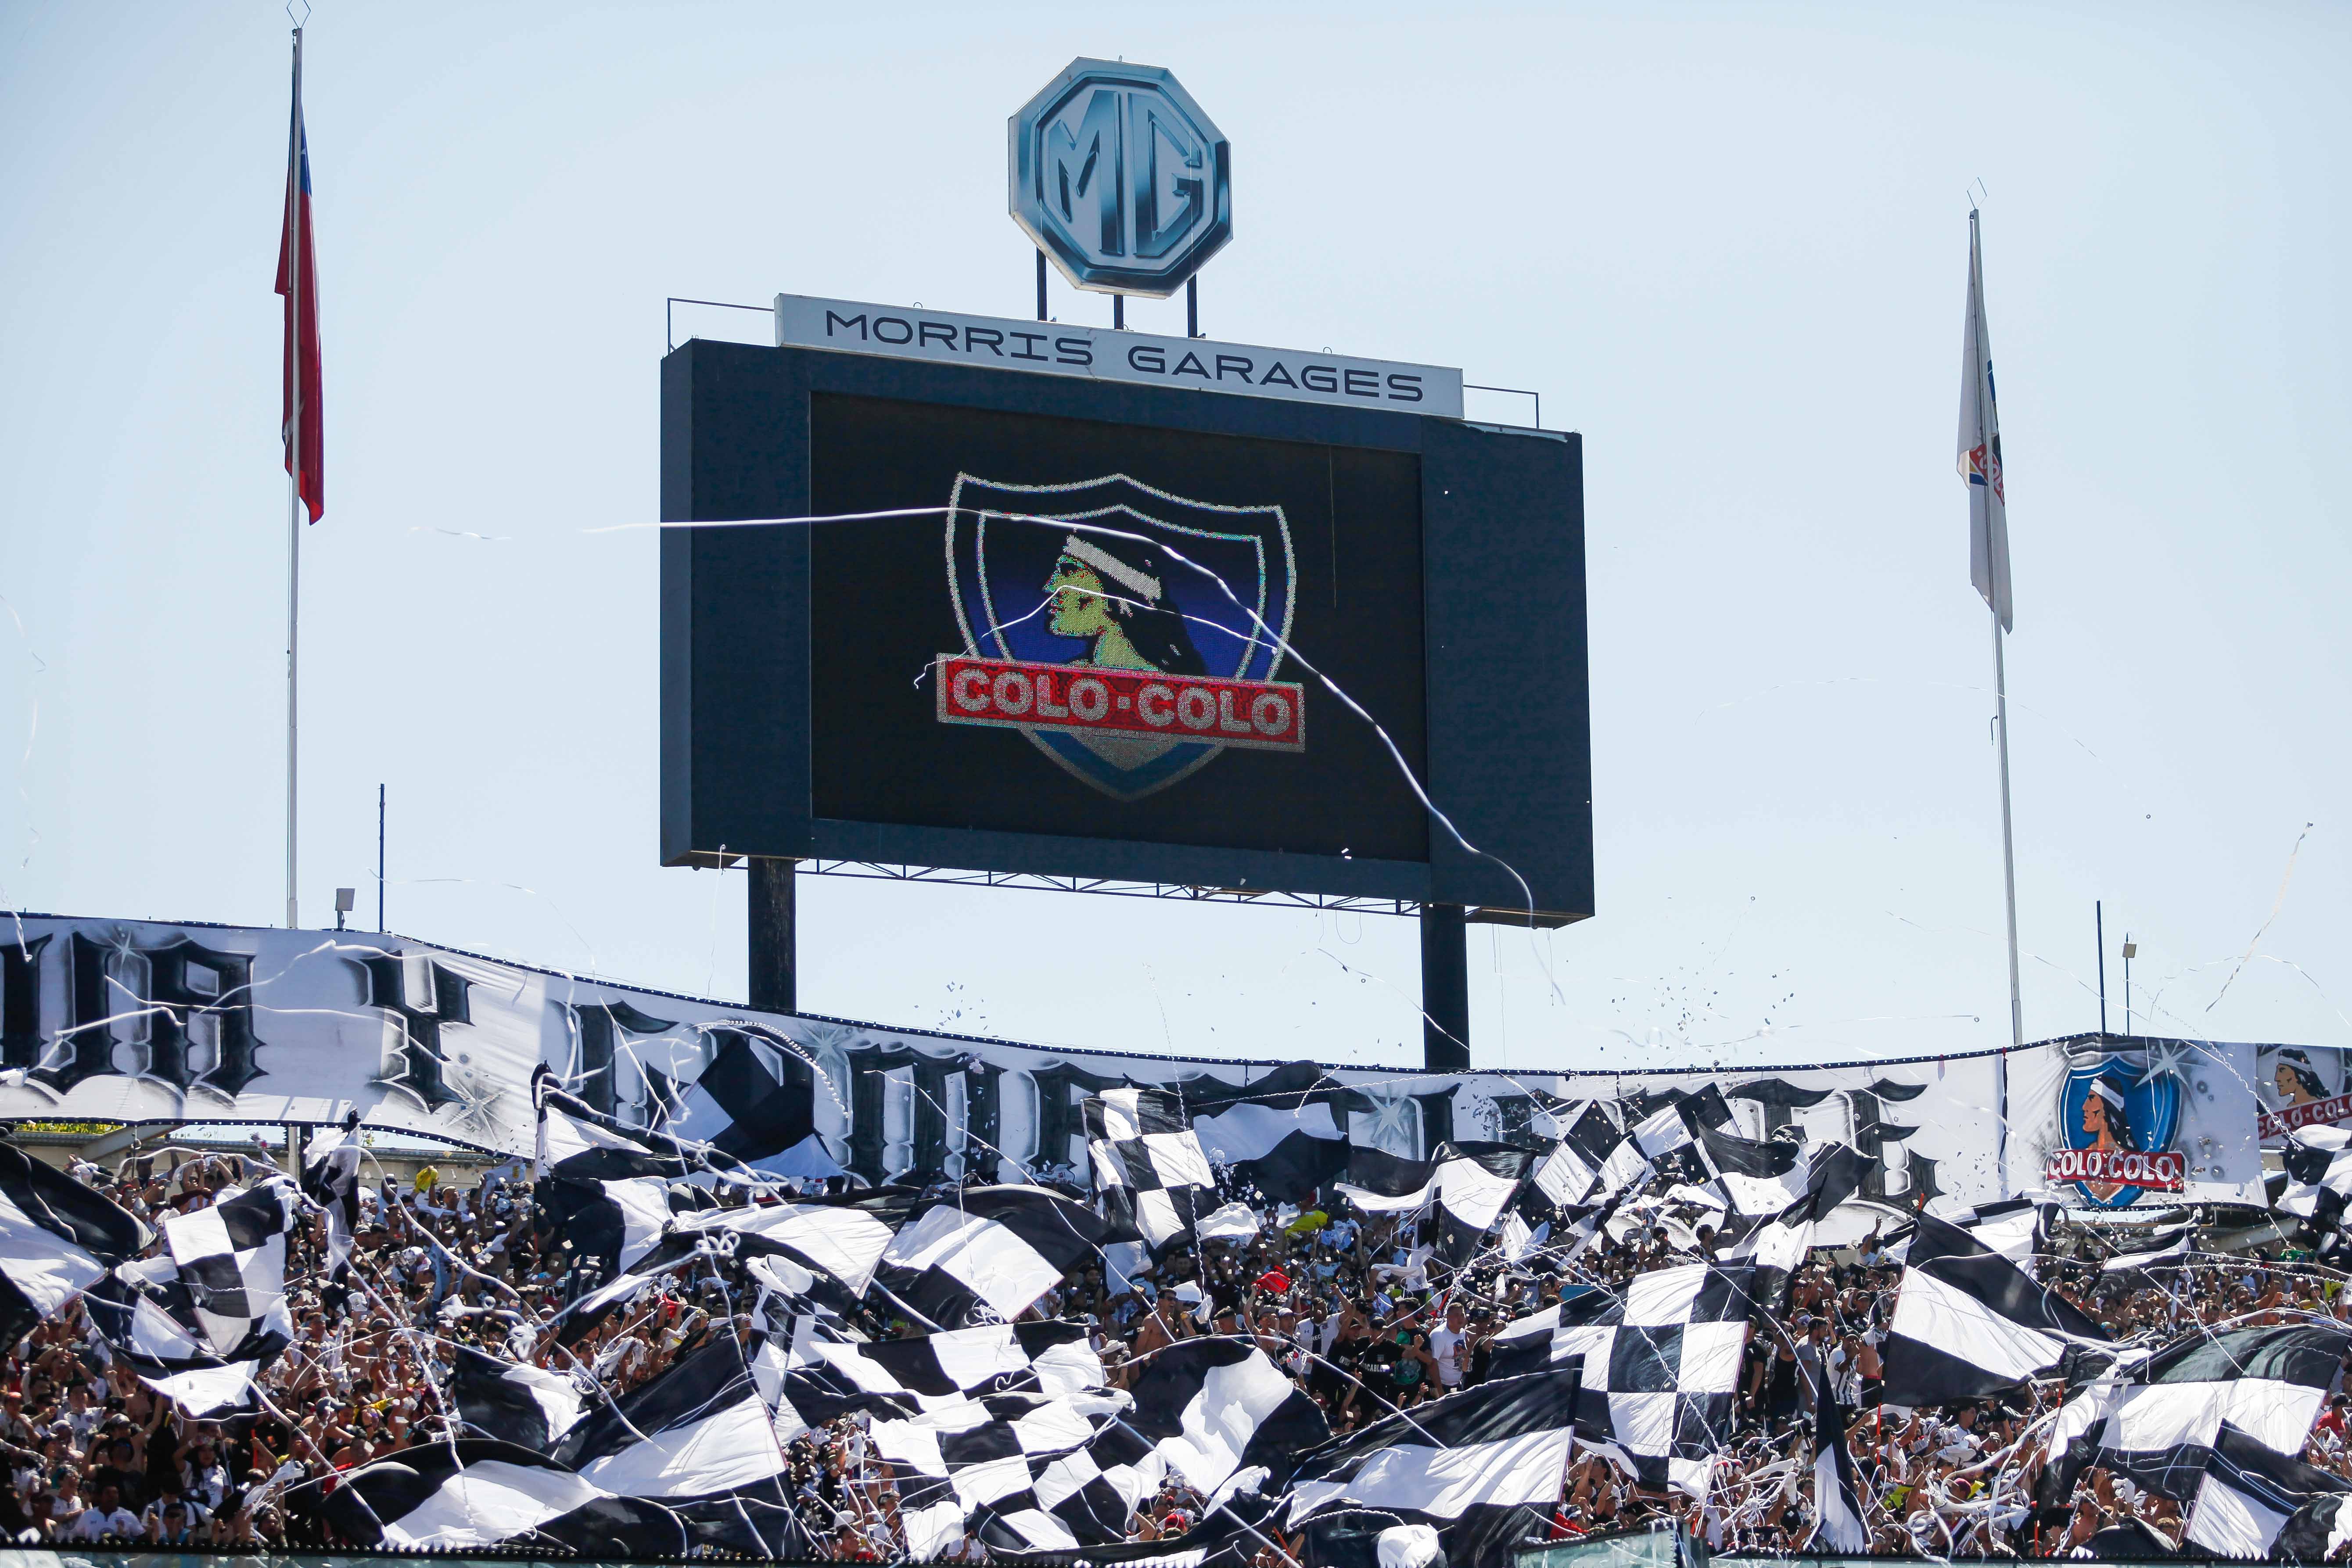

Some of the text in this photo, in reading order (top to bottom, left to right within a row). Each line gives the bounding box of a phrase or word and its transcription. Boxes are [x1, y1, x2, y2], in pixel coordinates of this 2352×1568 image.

[1048, 89, 1203, 259] MG
[826, 310, 1424, 402] MORRIS GARAGES
